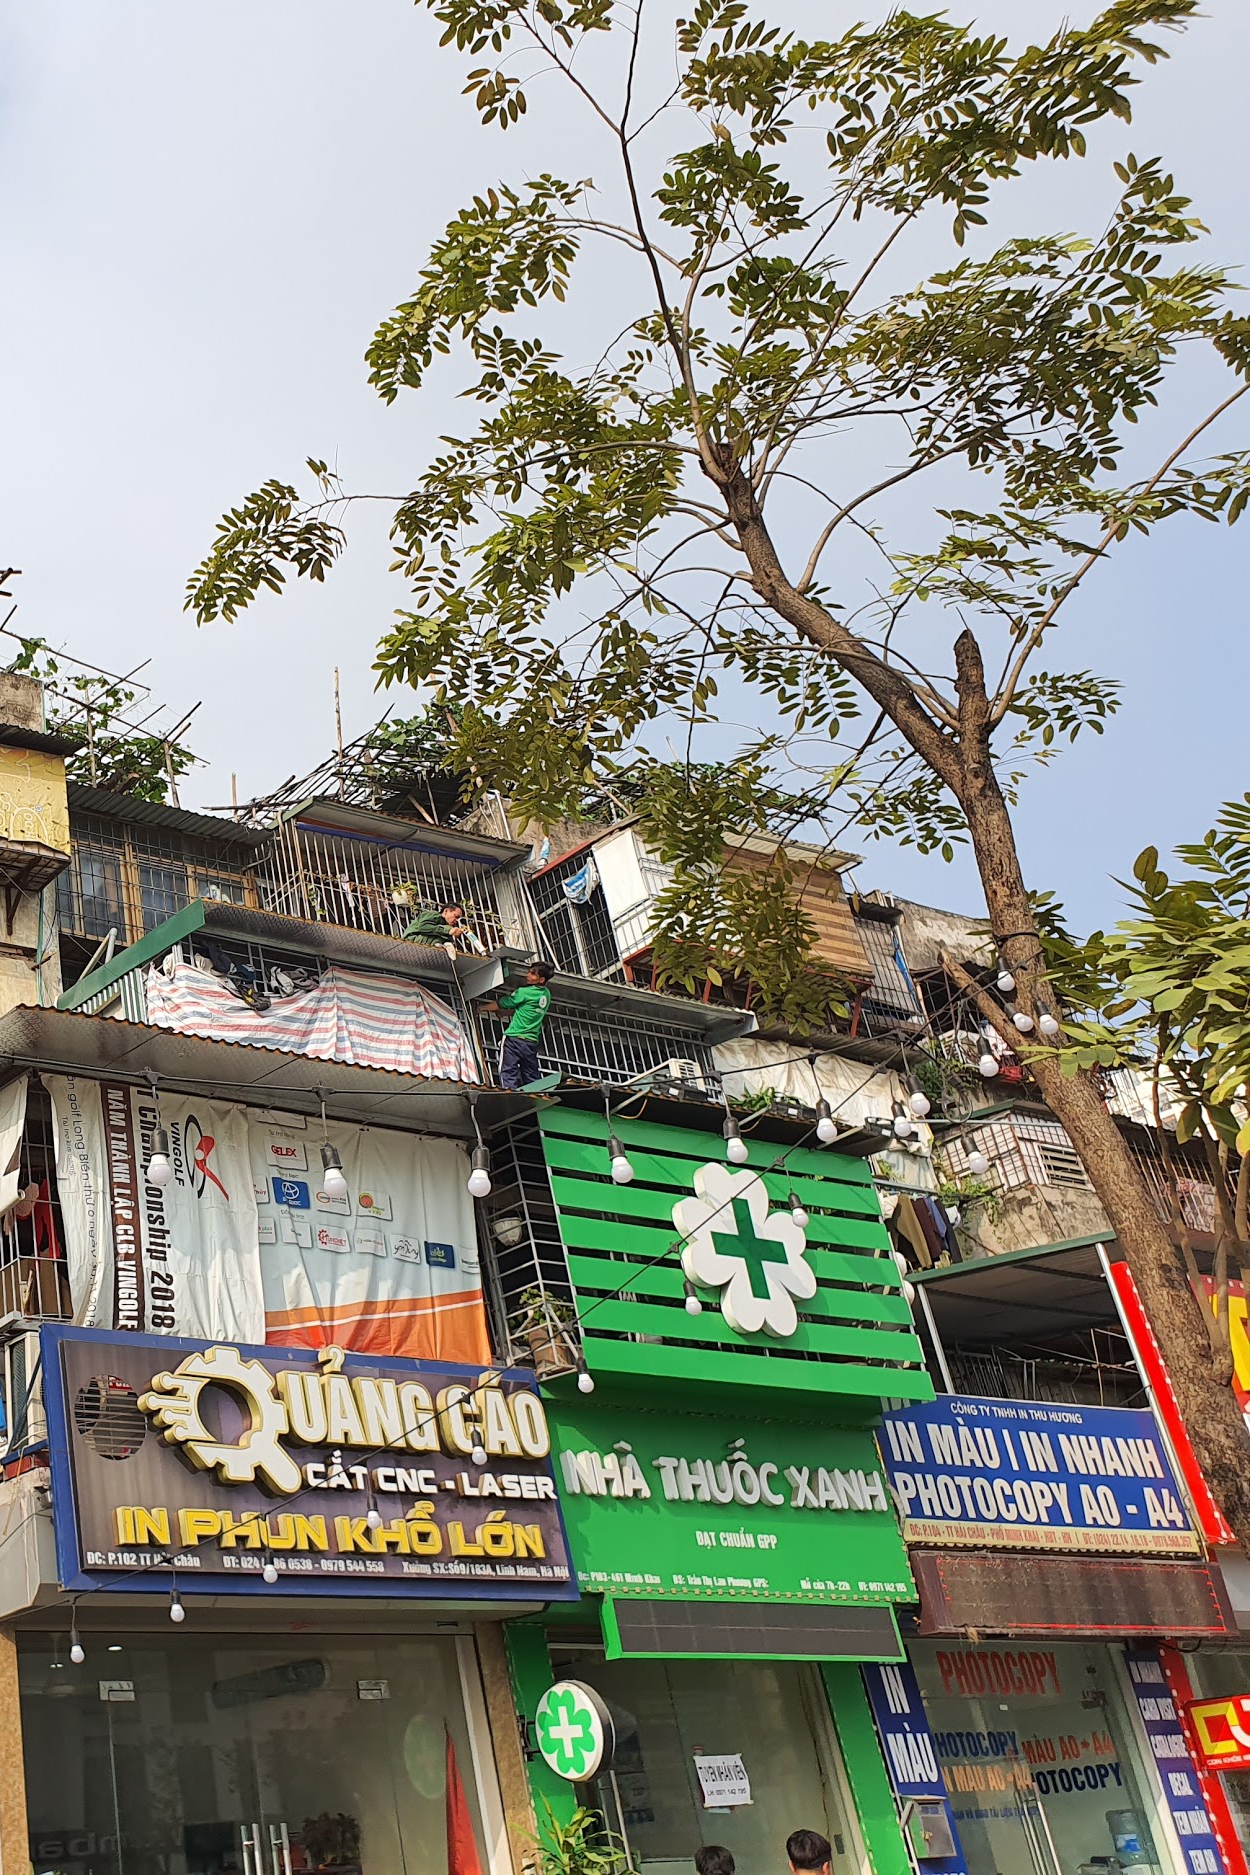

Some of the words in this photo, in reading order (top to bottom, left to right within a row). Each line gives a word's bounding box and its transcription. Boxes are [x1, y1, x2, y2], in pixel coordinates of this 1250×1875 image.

[67, 1093, 82, 1119] golf
[106, 1088, 125, 1126] NĂM
[73, 1119, 86, 1150] Long
[271, 1144, 297, 1157] GELEX
[110, 1132, 131, 1183] THÀNH
[170, 1121, 184, 1187] VINGOLF
[111, 1190, 133, 1220] LẬP
[116, 1225, 135, 1254] CLB
[116, 1257, 138, 1330] VINGOLF
[150, 1271, 176, 1330] 2018
[437, 1371, 550, 1458] CÁO
[950, 1402, 978, 1416] CÔNG
[980, 1406, 991, 1417] TY
[991, 1407, 1017, 1419] TNHH
[1018, 1409, 1028, 1420] IN
[1029, 1410, 1048, 1422] THU
[1049, 1411, 1083, 1424] HƯƠNG
[885, 1420, 926, 1463] IN
[926, 1417, 1001, 1469] MÀU
[1019, 1431, 1059, 1473] IN
[1057, 1433, 1165, 1479] NHANH
[302, 1450, 367, 1490] CẮT
[373, 1467, 438, 1494] CNC
[456, 1472, 557, 1500] LASER
[559, 1440, 651, 1499] NHÀ
[652, 1437, 784, 1506] THUỐC
[783, 1465, 888, 1513] XANH
[893, 1471, 1074, 1525] PHOTOCOPY
[1143, 1487, 1184, 1528] A4
[112, 1506, 171, 1546] IN
[177, 1508, 329, 1551] PHUN
[334, 1500, 443, 1556] KHỔ
[448, 1510, 546, 1558] LỚN
[695, 1530, 718, 1550] ĐẠT
[719, 1526, 756, 1549] CHUẨN
[757, 1533, 777, 1550] GPP
[86, 1552, 106, 1565] ĐC:
[108, 1553, 138, 1566] P.102
[139, 1553, 152, 1566] TT
[174, 1554, 201, 1567] Châu
[222, 1555, 240, 1568] ĐT:
[241, 1556, 260, 1569] 024
[288, 1558, 313, 1570] 0538
[321, 1559, 345, 1571] 0979
[540, 1564, 553, 1577] Hà
[554, 1564, 570, 1580] Nội
[879, 1666, 910, 1714] IN
[936, 1650, 1062, 1696] PHOTOCOPY
[886, 1722, 938, 1783] MÀU
[933, 1731, 1019, 1758] HOTOCOPY
[1021, 1734, 1057, 1764] MÀU
[953, 1760, 986, 1792] MÀU
[1031, 1761, 1122, 1795] OTOCOPY
